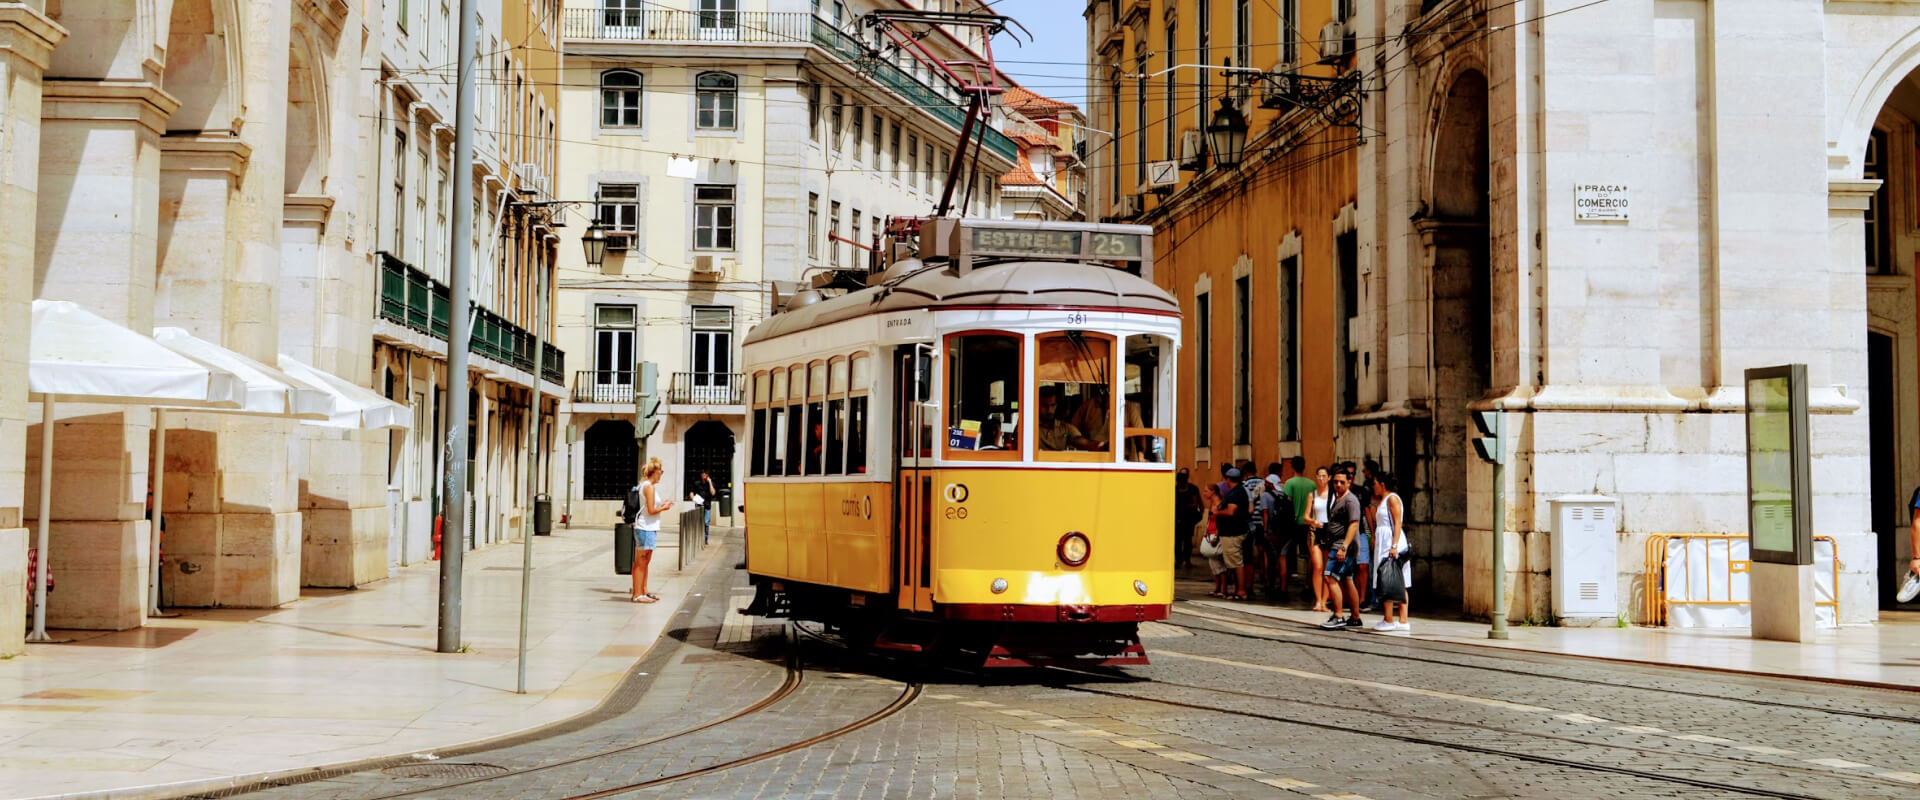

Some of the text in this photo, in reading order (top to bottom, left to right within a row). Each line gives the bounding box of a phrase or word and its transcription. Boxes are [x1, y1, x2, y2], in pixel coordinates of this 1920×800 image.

[1584, 185, 1621, 194] PRAÇA
[1577, 198, 1629, 208] COMERCIO
[979, 230, 1073, 249] ESTRELA
[1094, 234, 1125, 254] 25
[887, 317, 911, 327] ENTRADA
[1067, 313, 1087, 325] 581
[950, 438, 960, 447] 01
